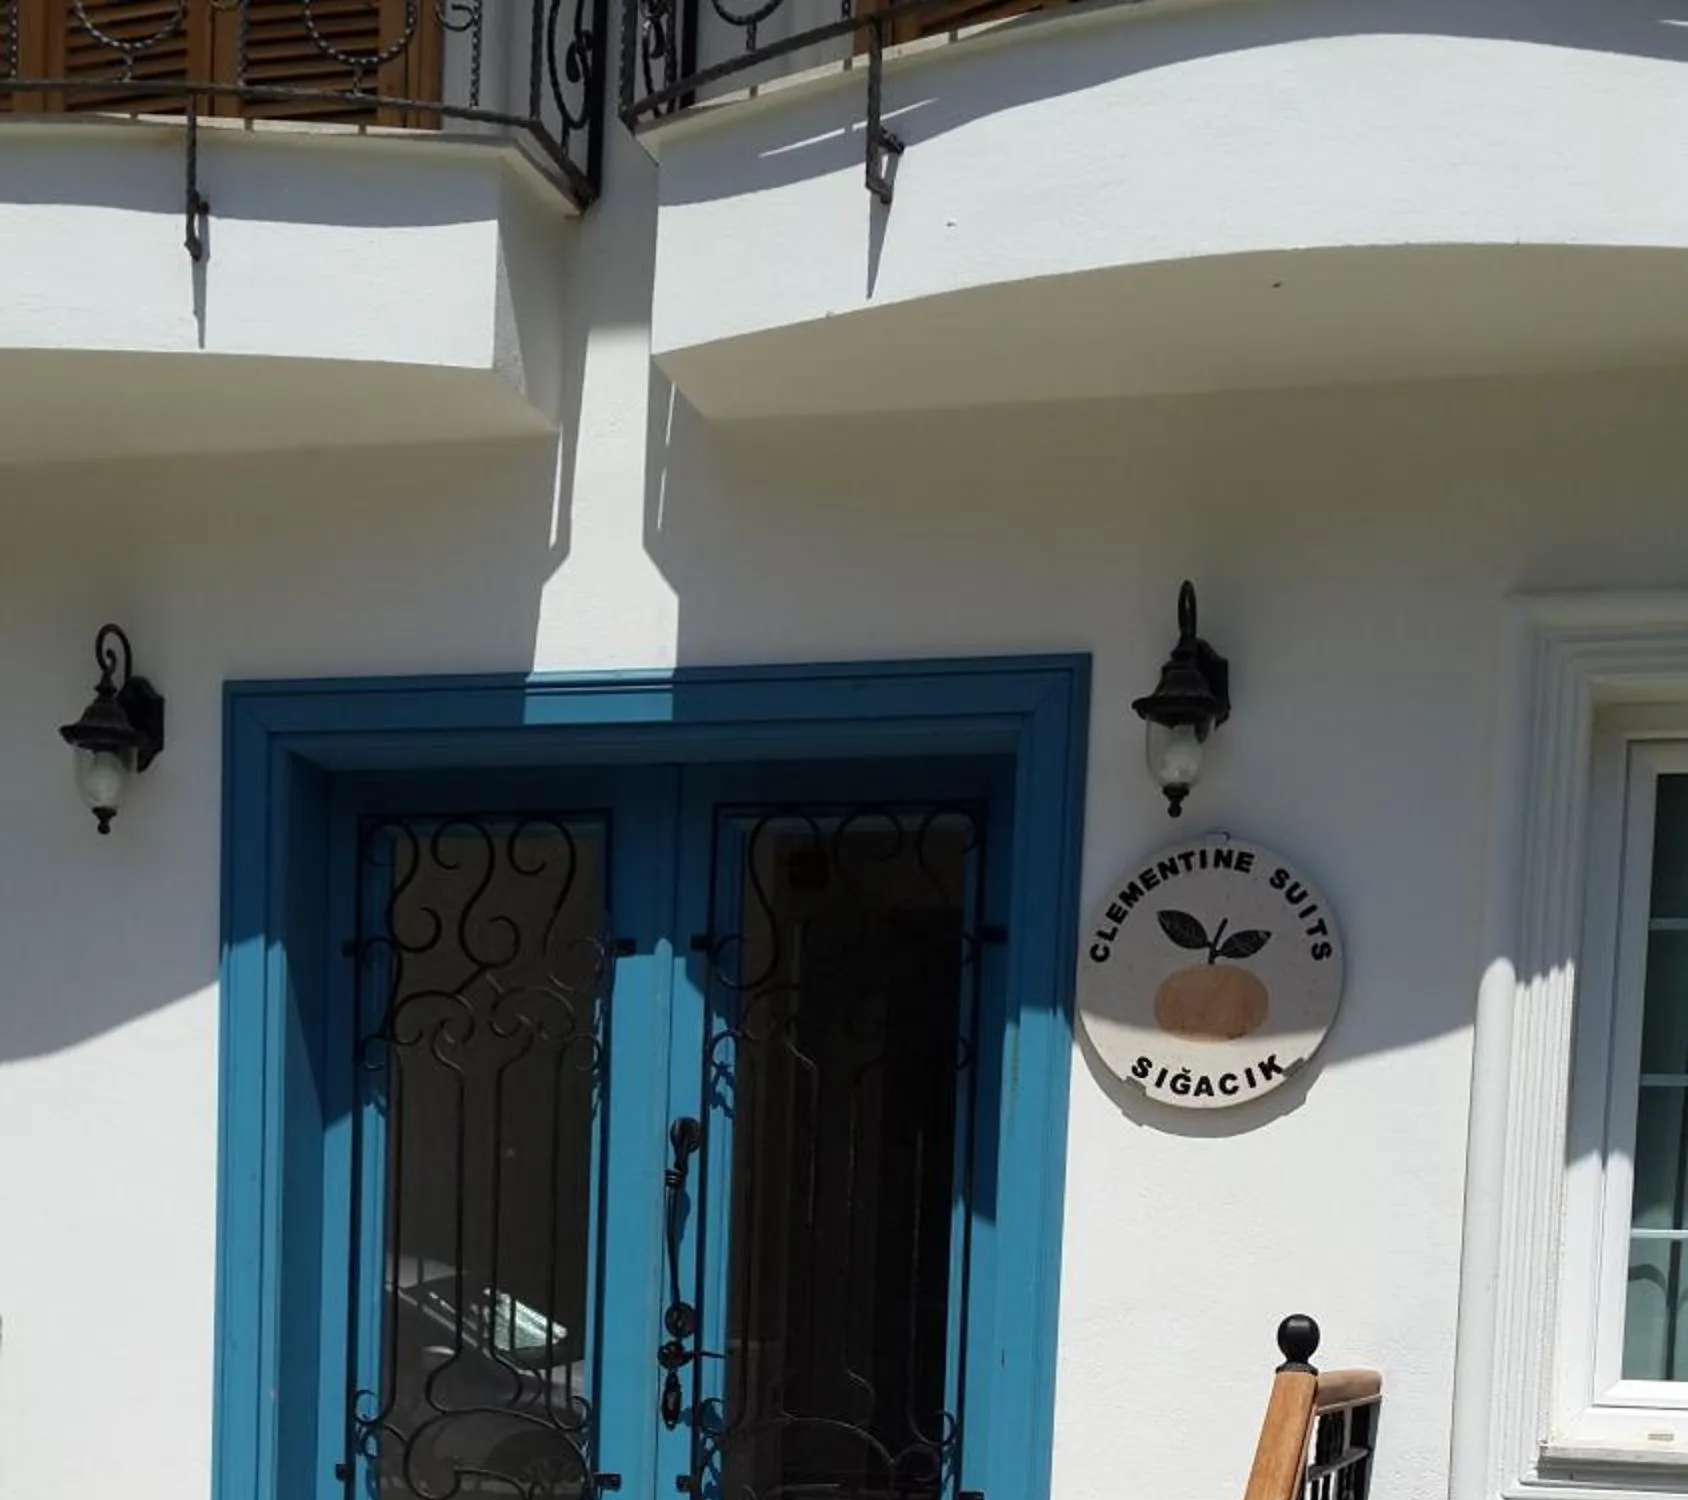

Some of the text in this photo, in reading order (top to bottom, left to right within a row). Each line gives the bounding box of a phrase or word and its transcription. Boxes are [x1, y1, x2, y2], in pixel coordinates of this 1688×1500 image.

[1090, 849, 1332, 963] CLEMENTINE SUITS
[1132, 1055, 1283, 1096] SIĞACIK
